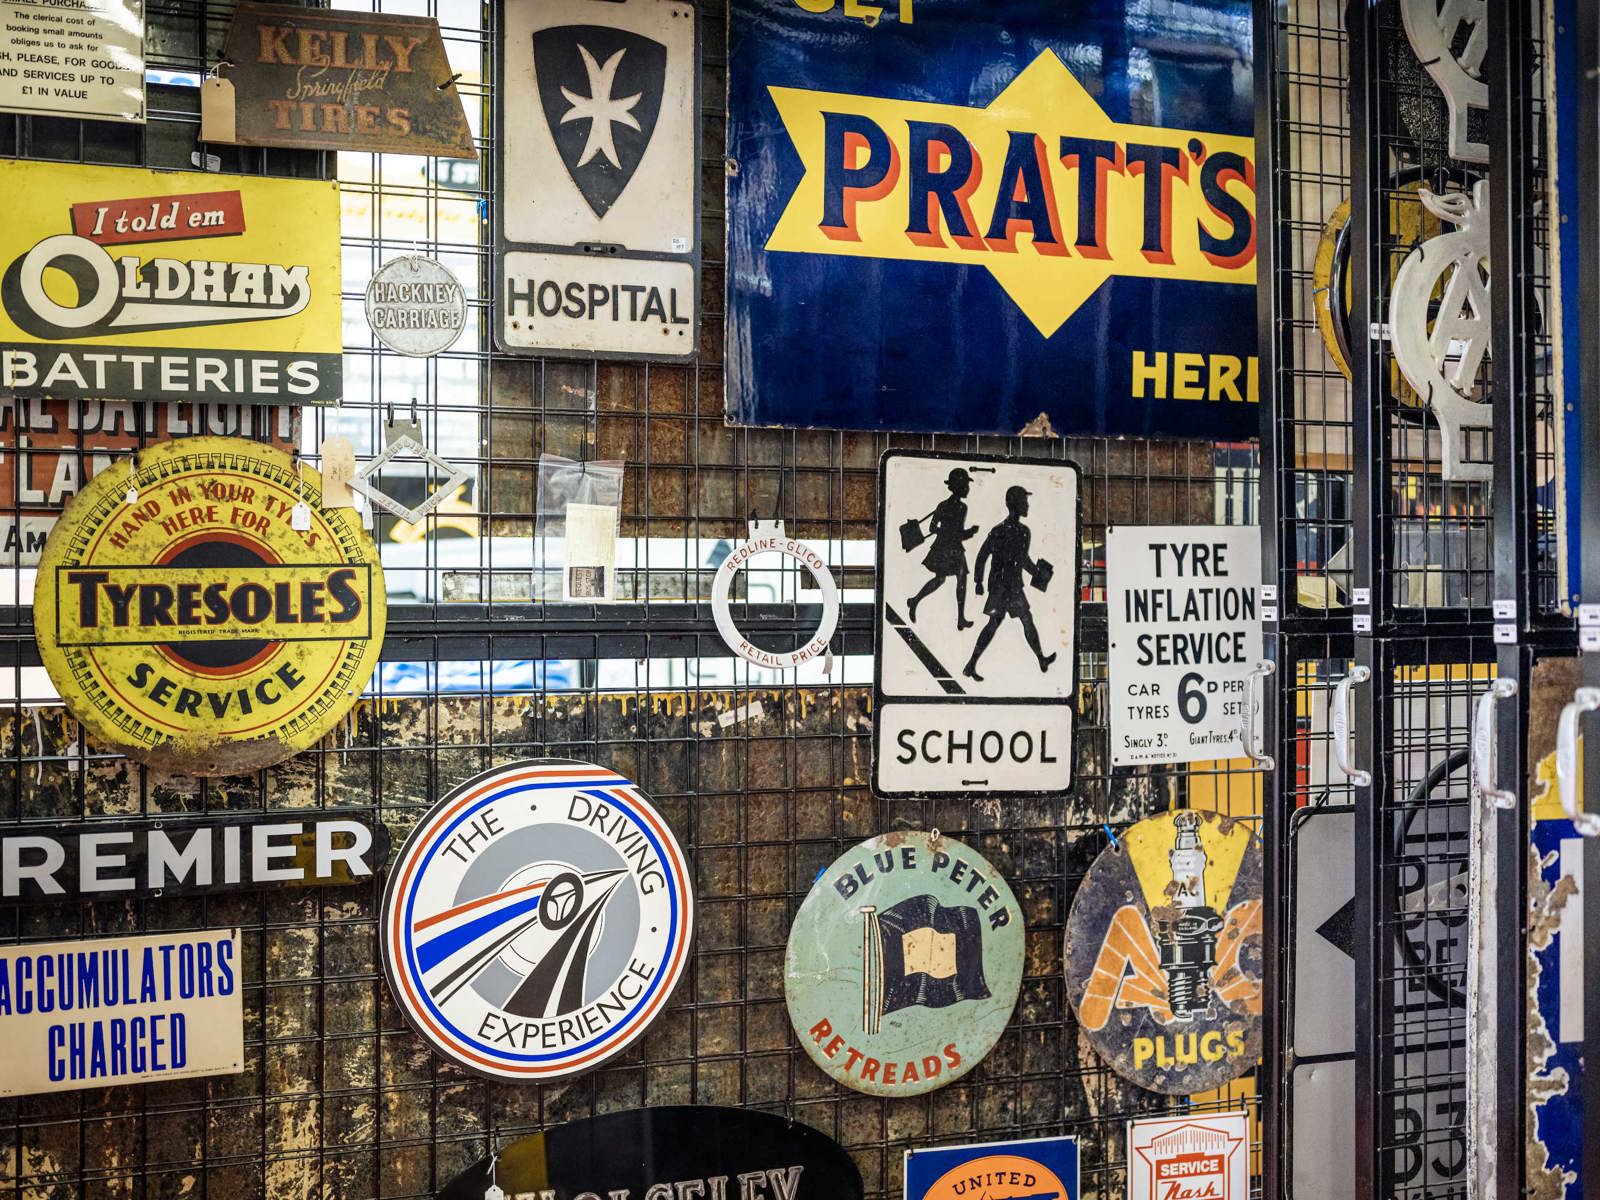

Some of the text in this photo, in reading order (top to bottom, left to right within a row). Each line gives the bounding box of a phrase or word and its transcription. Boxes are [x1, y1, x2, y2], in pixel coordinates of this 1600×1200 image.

[6, 24, 103, 40] booking small amounts
[14, 11, 30, 20] The
[32, 13, 63, 23] clerical
[65, 17, 84, 26] cost
[10, 38, 41, 47] obliges
[69, 43, 84, 51] ask
[87, 44, 98, 52] for
[64, 57, 86, 67] FOR
[257, 24, 422, 73] KELLY
[22, 85, 88, 99] £1 IN VALUE
[23, 69, 76, 82] SERVICES
[80, 74, 95, 83] UP
[99, 76, 115, 86] TO
[286, 54, 393, 104] Springfield
[269, 99, 412, 138] TIRES
[818, 110, 1257, 269] PRATT'S
[92, 207, 108, 236] I
[115, 202, 178, 233] told
[20, 234, 312, 328] OLDHAM
[374, 282, 457, 303] HACKNEY
[374, 308, 461, 330] CARRIAGE
[508, 278, 690, 325] HOSPITAL
[2, 351, 320, 394] BATTERIES
[109, 500, 161, 550] HAND
[168, 487, 192, 509] IN
[202, 481, 256, 504] YOUR
[160, 505, 271, 537] HERE FOR
[726, 538, 823, 572] REDLINE-GLICO
[1149, 543, 1229, 578] TYRE
[66, 568, 362, 628] TYRESOLES
[1125, 587, 1256, 623] INFLATION
[739, 636, 827, 666] RETAIL PRICE
[1137, 632, 1247, 667] SERVICE
[127, 661, 306, 720] SERVICE
[1128, 683, 1161, 696] CAR
[1223, 680, 1245, 693] PER
[1128, 705, 1170, 720] TYRES
[896, 729, 1057, 765] SCHOOL
[442, 795, 666, 896] THE DRIVING
[834, 846, 1013, 931] BLUE PETER
[0, 939, 235, 1016] ACCUMULATORS
[478, 957, 656, 1049] EXPERIENCE
[48, 1012, 187, 1083] CHARGED
[808, 1017, 963, 1086] RETREADS
[1133, 1030, 1247, 1071] PLUGS
[952, 1171, 1038, 1196] UNITED
[1160, 1159, 1219, 1176] SERVICE
[1160, 1180, 1220, 1200] Nash
